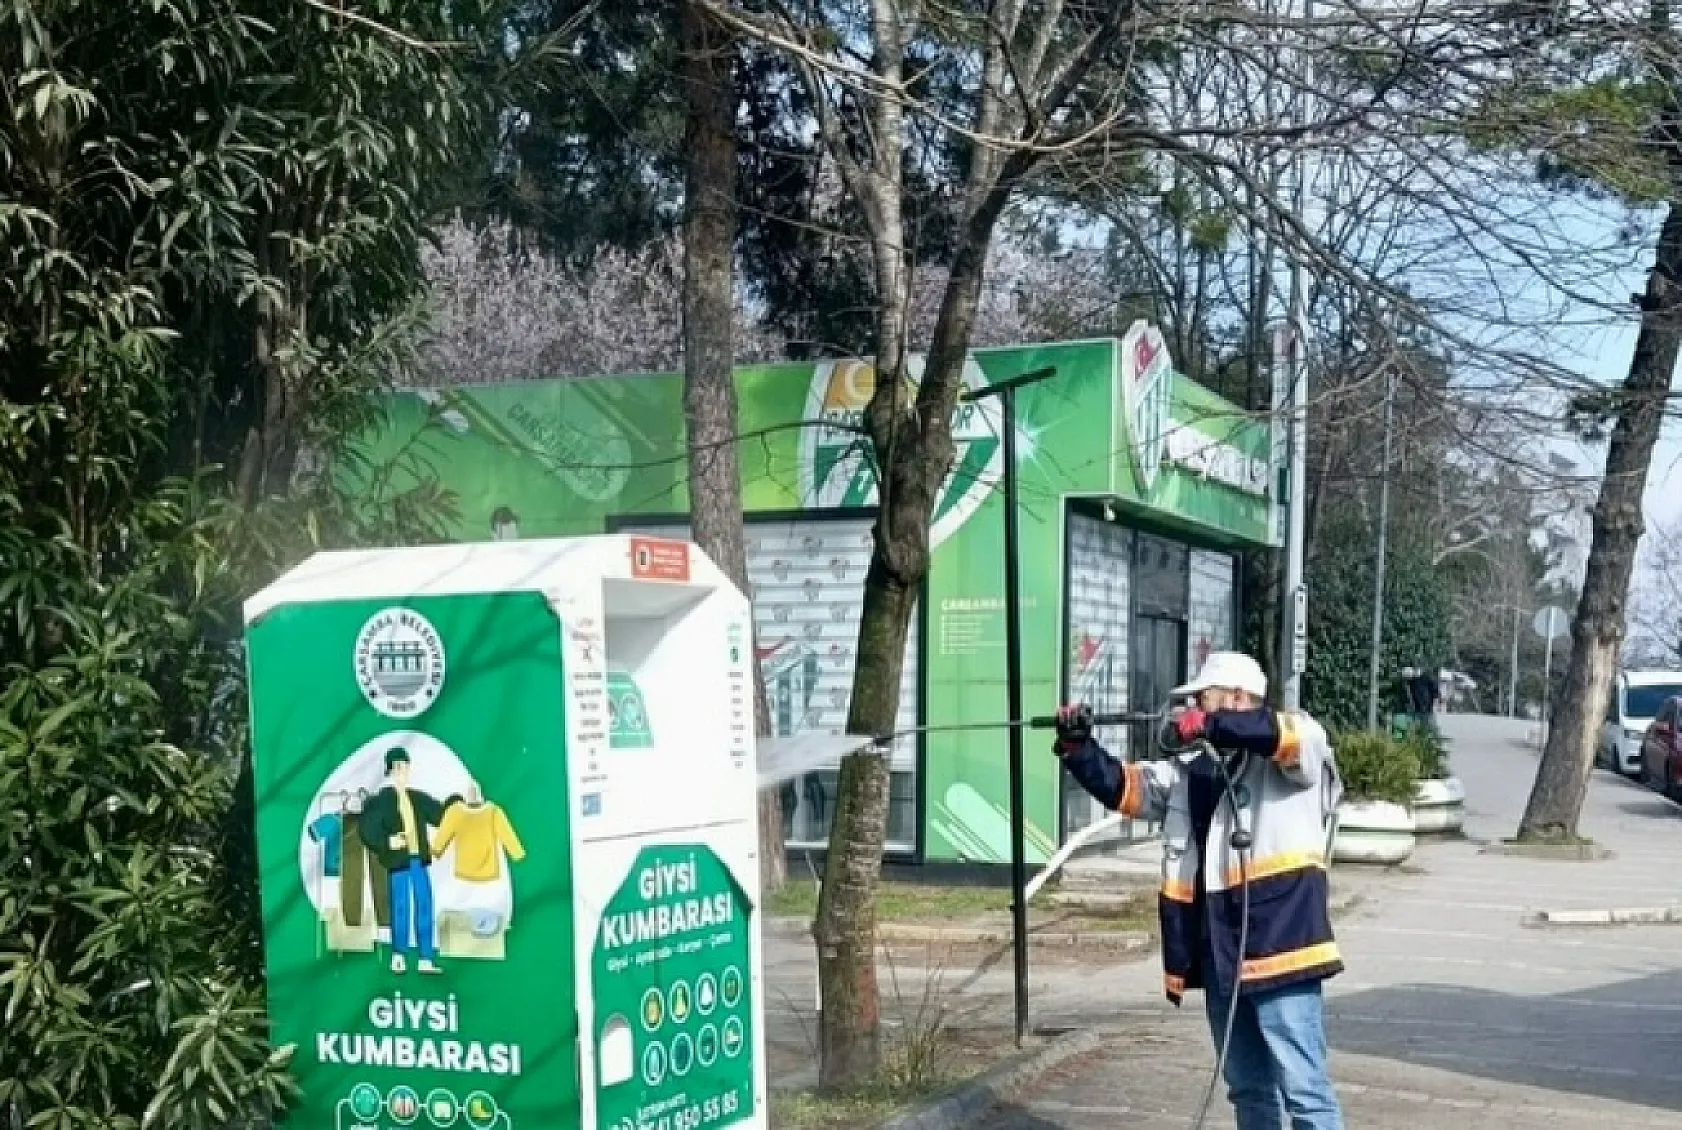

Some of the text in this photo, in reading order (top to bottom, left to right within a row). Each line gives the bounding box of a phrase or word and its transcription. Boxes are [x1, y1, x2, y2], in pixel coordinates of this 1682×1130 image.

[638, 852, 697, 901] GİYSİ
[603, 891, 733, 951] KUMBARASI
[368, 991, 459, 1033] GİYSİ
[316, 1032, 522, 1075] KUMBARASI
